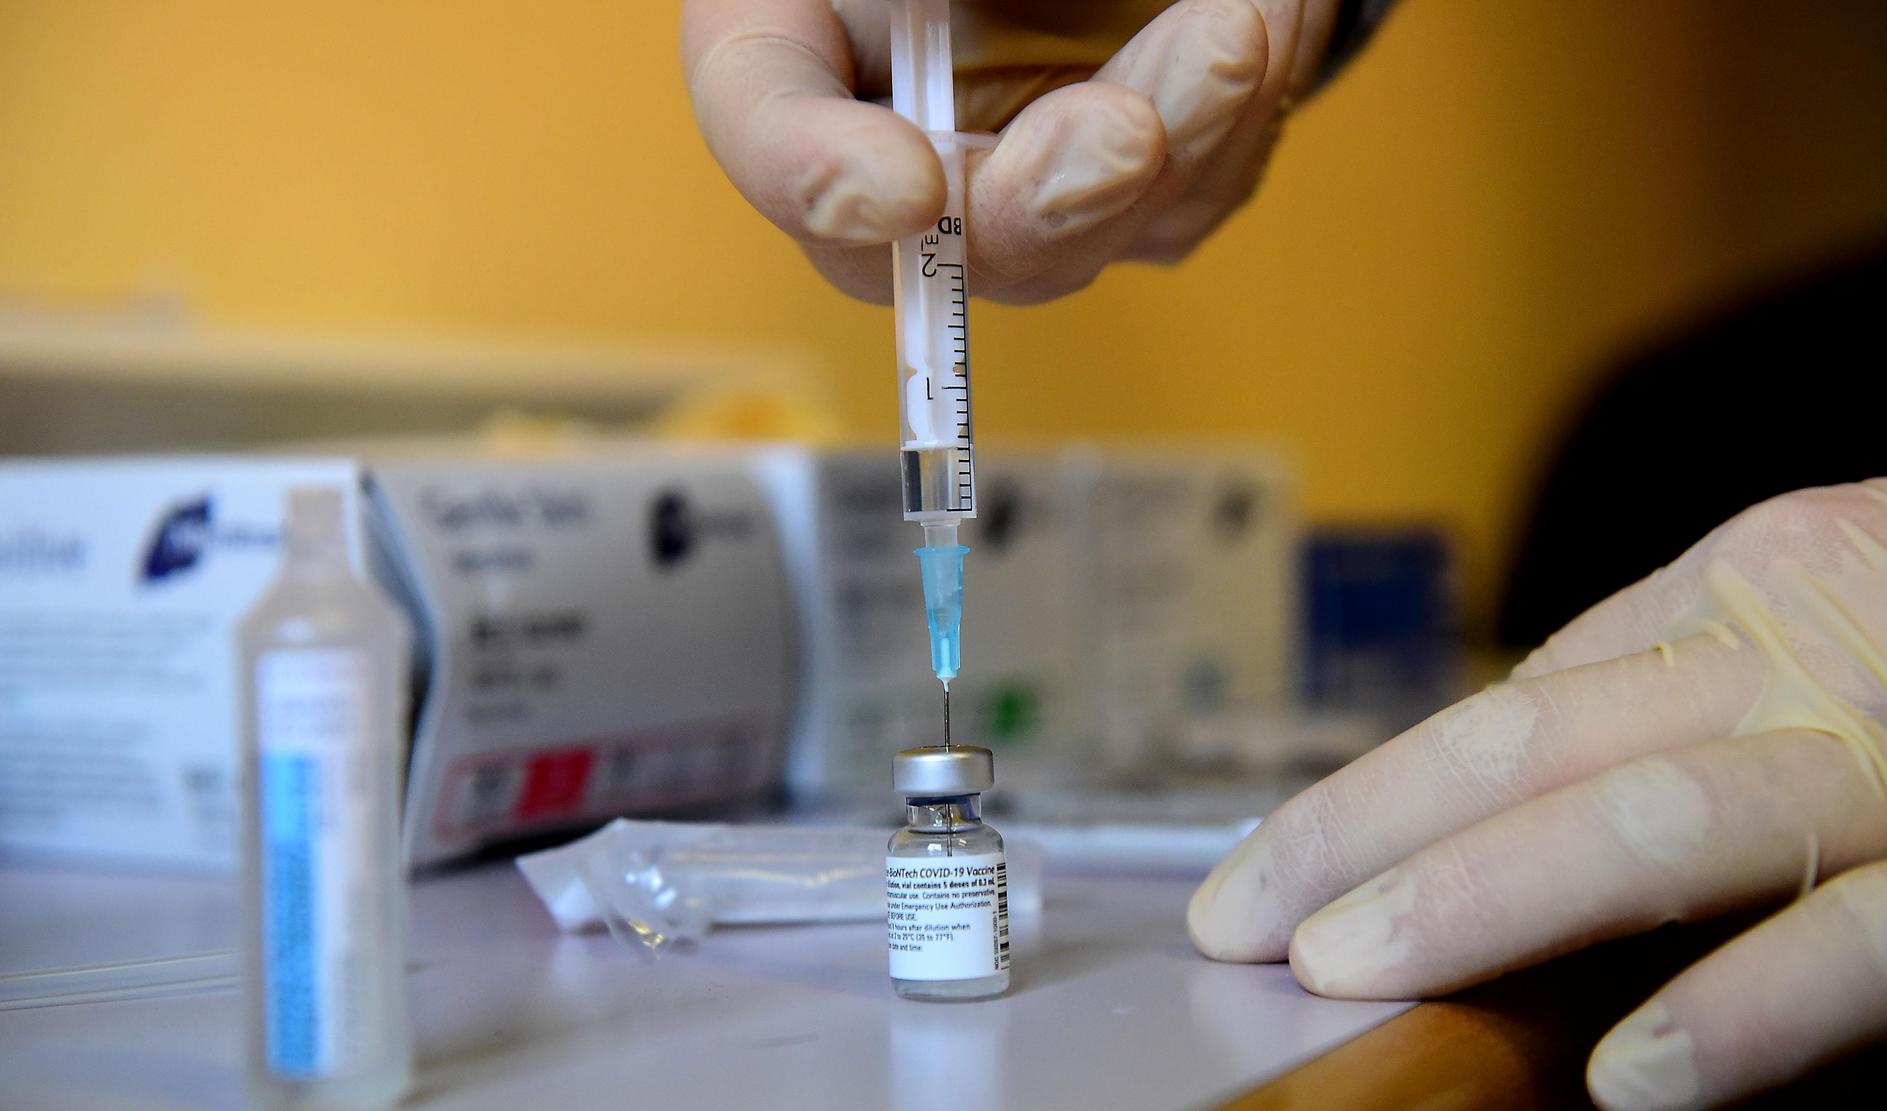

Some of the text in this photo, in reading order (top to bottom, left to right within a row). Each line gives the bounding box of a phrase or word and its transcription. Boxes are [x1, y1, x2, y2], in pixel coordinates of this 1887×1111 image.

[938, 216, 962, 235] BD
[922, 253, 938, 277] 2
[925, 377, 934, 400] 1
[920, 867, 964, 878] COVID-19
[966, 866, 995, 877] Vaccine
[902, 881, 912, 889] vial
[913, 881, 941, 889] contains
[949, 880, 969, 888] doses
[971, 879, 977, 887] of
[901, 902, 933, 911] Emergency
[924, 924, 949, 932] dilution
[951, 923, 971, 931] when
